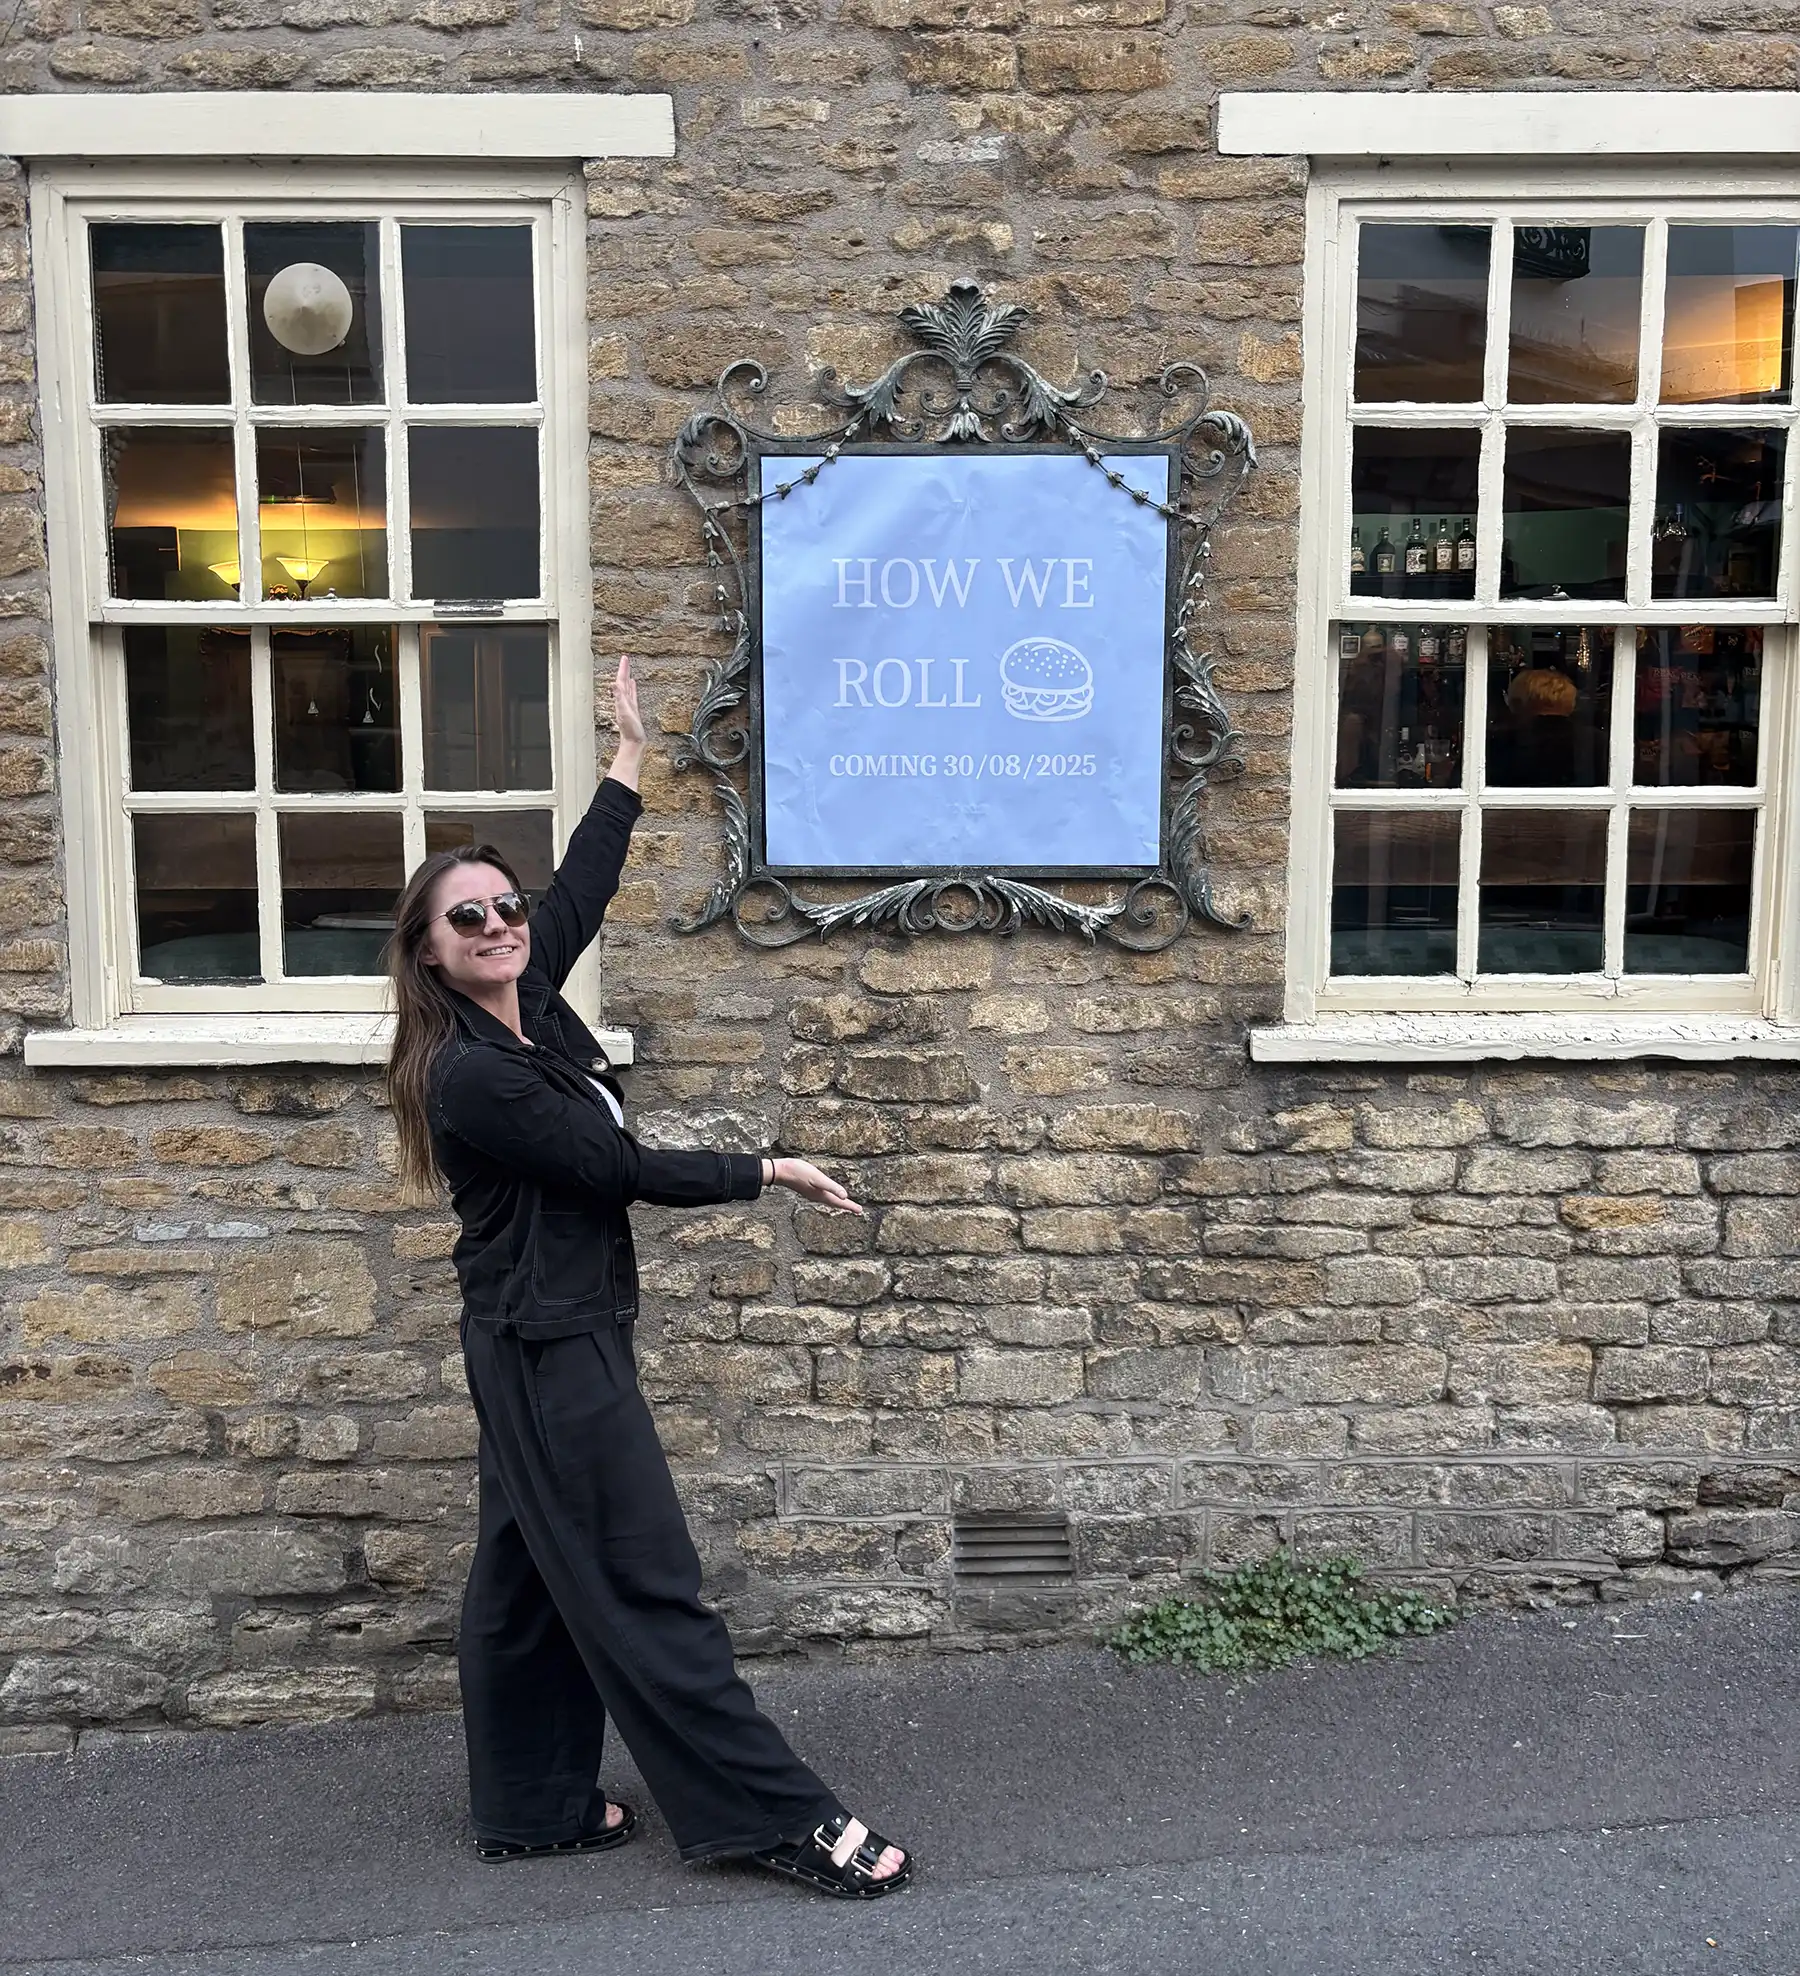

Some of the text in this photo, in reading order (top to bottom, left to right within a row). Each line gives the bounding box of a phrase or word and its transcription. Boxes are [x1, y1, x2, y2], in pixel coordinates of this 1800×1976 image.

[832, 557, 1095, 608] HOW WE
[833, 657, 982, 708] ROLL
[829, 755, 1097, 779] COMING 30/08/2025
